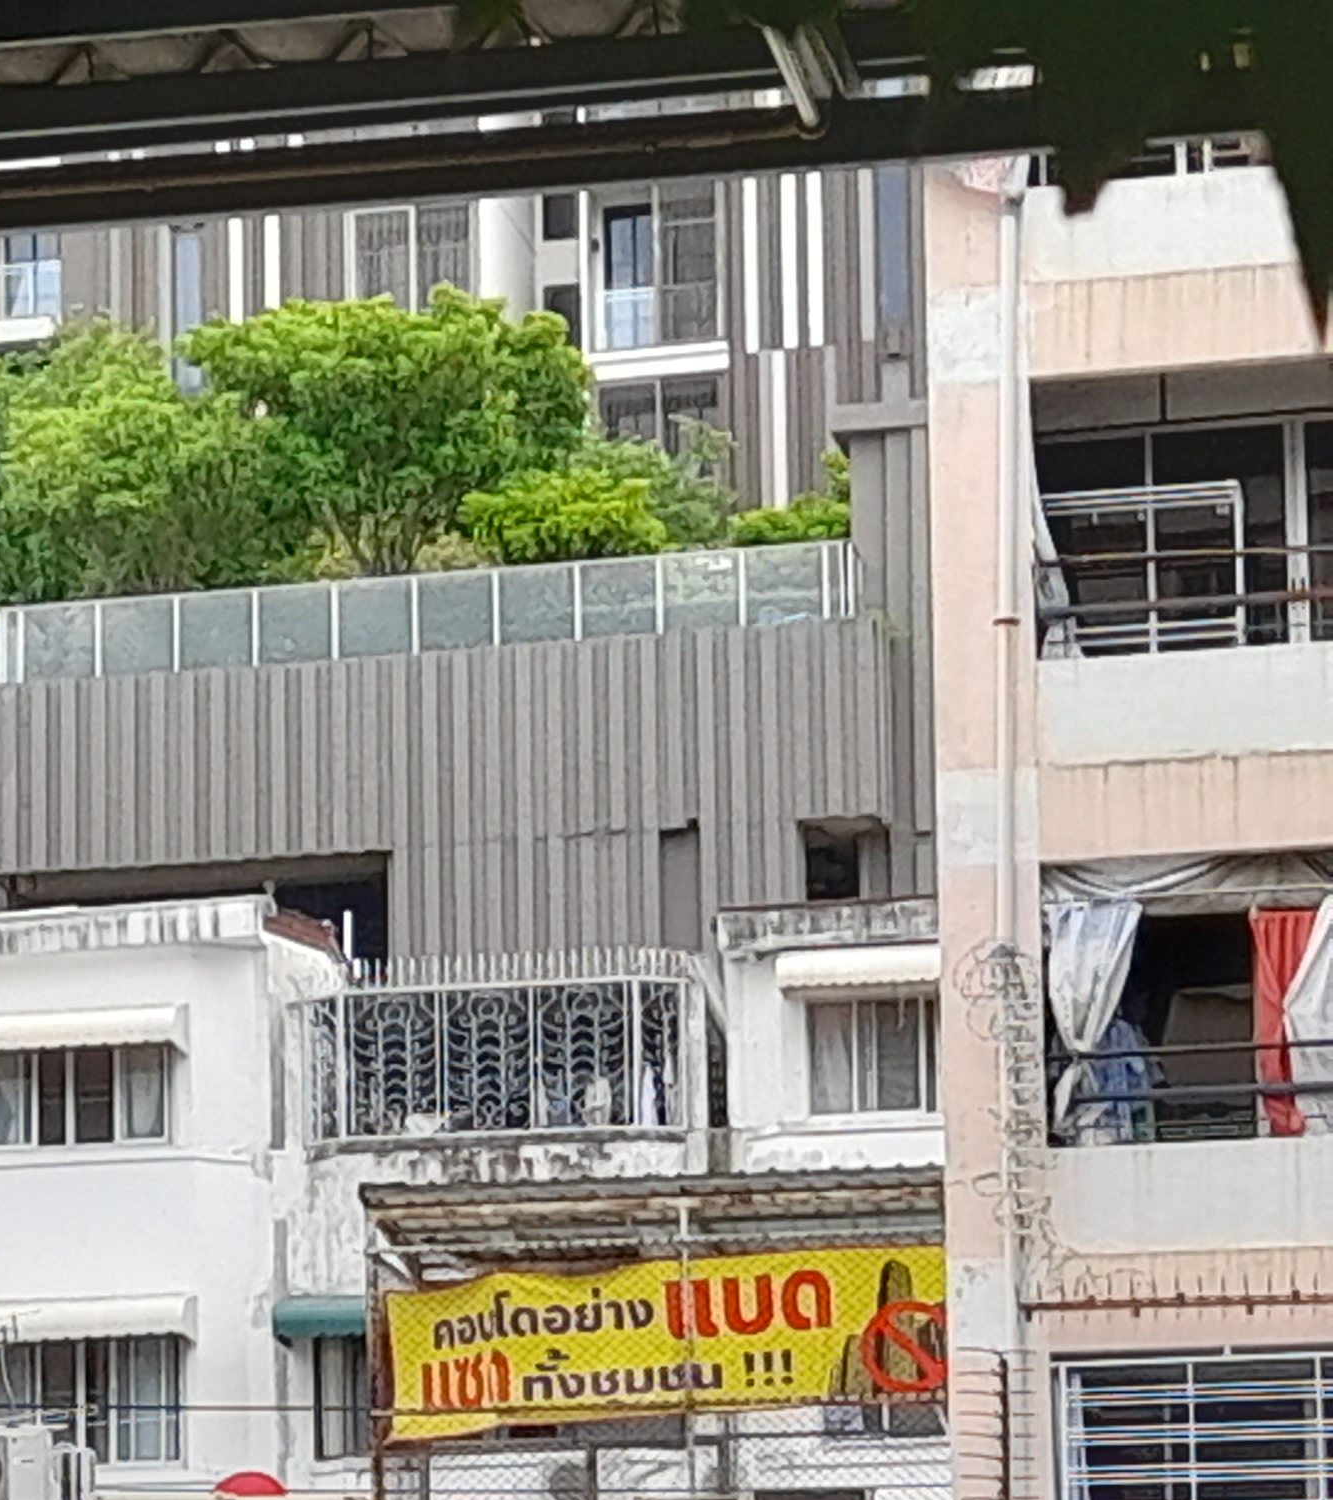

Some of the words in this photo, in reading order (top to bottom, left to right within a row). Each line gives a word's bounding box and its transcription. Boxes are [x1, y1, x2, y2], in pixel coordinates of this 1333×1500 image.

[432, 1287, 655, 1351] คอนโดอย่าง
[663, 1269, 832, 1339] แบด
